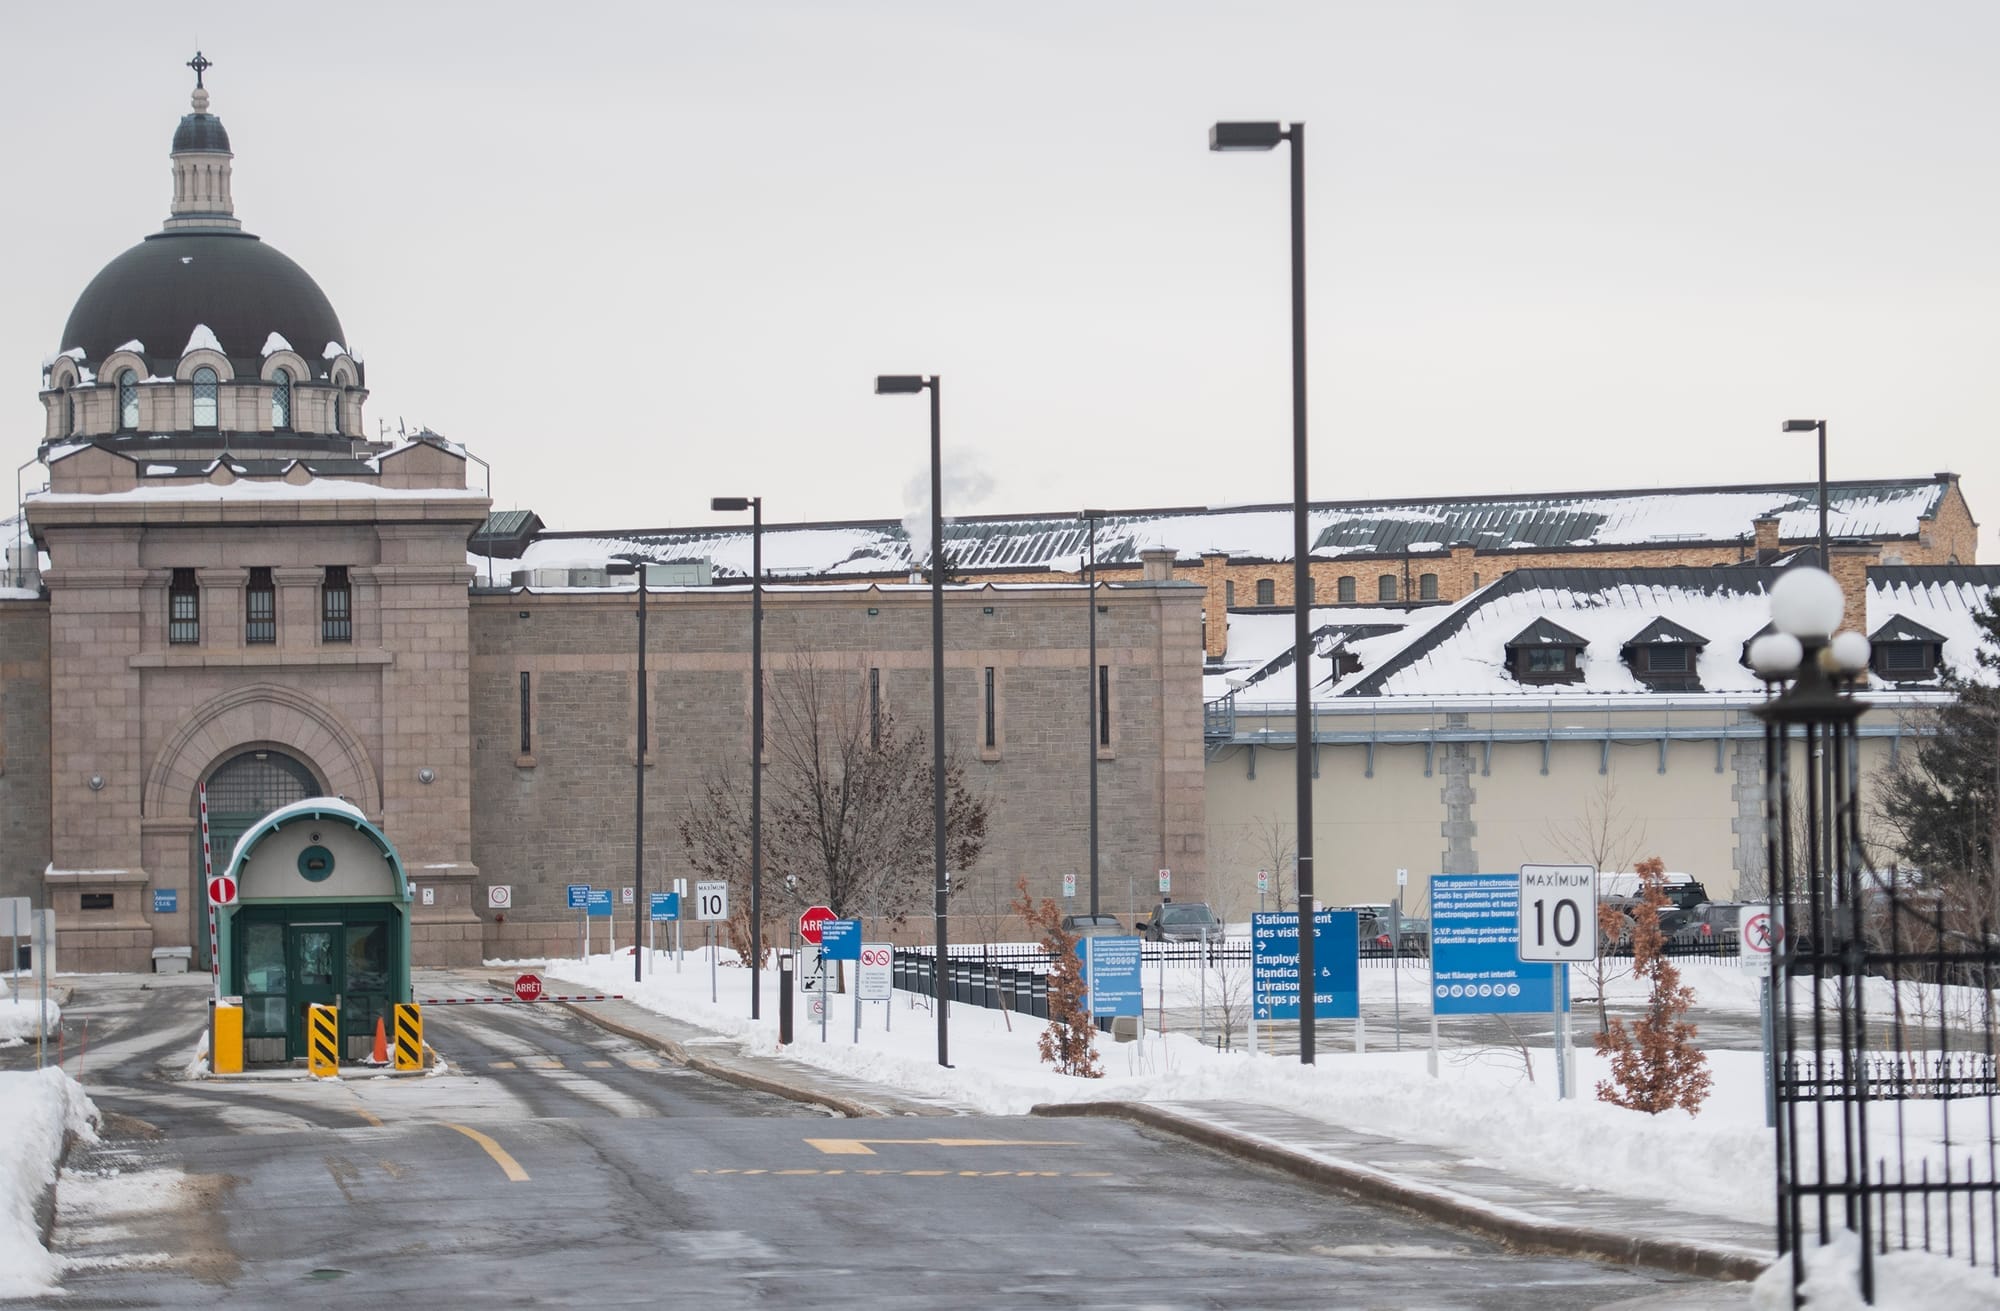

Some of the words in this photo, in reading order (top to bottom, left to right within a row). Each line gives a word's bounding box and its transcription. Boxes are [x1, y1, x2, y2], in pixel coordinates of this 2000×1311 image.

[1450, 880, 1478, 888] appareil
[1527, 874, 1590, 886] MAXIMUM
[1453, 891, 1463, 899] les
[1464, 891, 1490, 900] piétons
[1490, 891, 1518, 900] peuvent
[702, 895, 722, 915] 10
[1455, 901, 1491, 910] personnels
[1256, 914, 1332, 925] Stationnent
[1434, 911, 1479, 919] électroniques
[802, 919, 823, 931] ARR
[1534, 898, 1581, 947] 10
[1256, 927, 1275, 938] des
[1277, 927, 1321, 937] visits
[1479, 927, 1512, 936] présenter
[1434, 936, 1466, 944] d'identité
[1478, 936, 1497, 944] poste
[1256, 953, 1301, 966] Employé
[1256, 967, 1317, 978] Handica
[516, 982, 540, 992] ARRÊT
[1257, 994, 1287, 1006] Corps
[1290, 993, 1333, 1006] poiers
